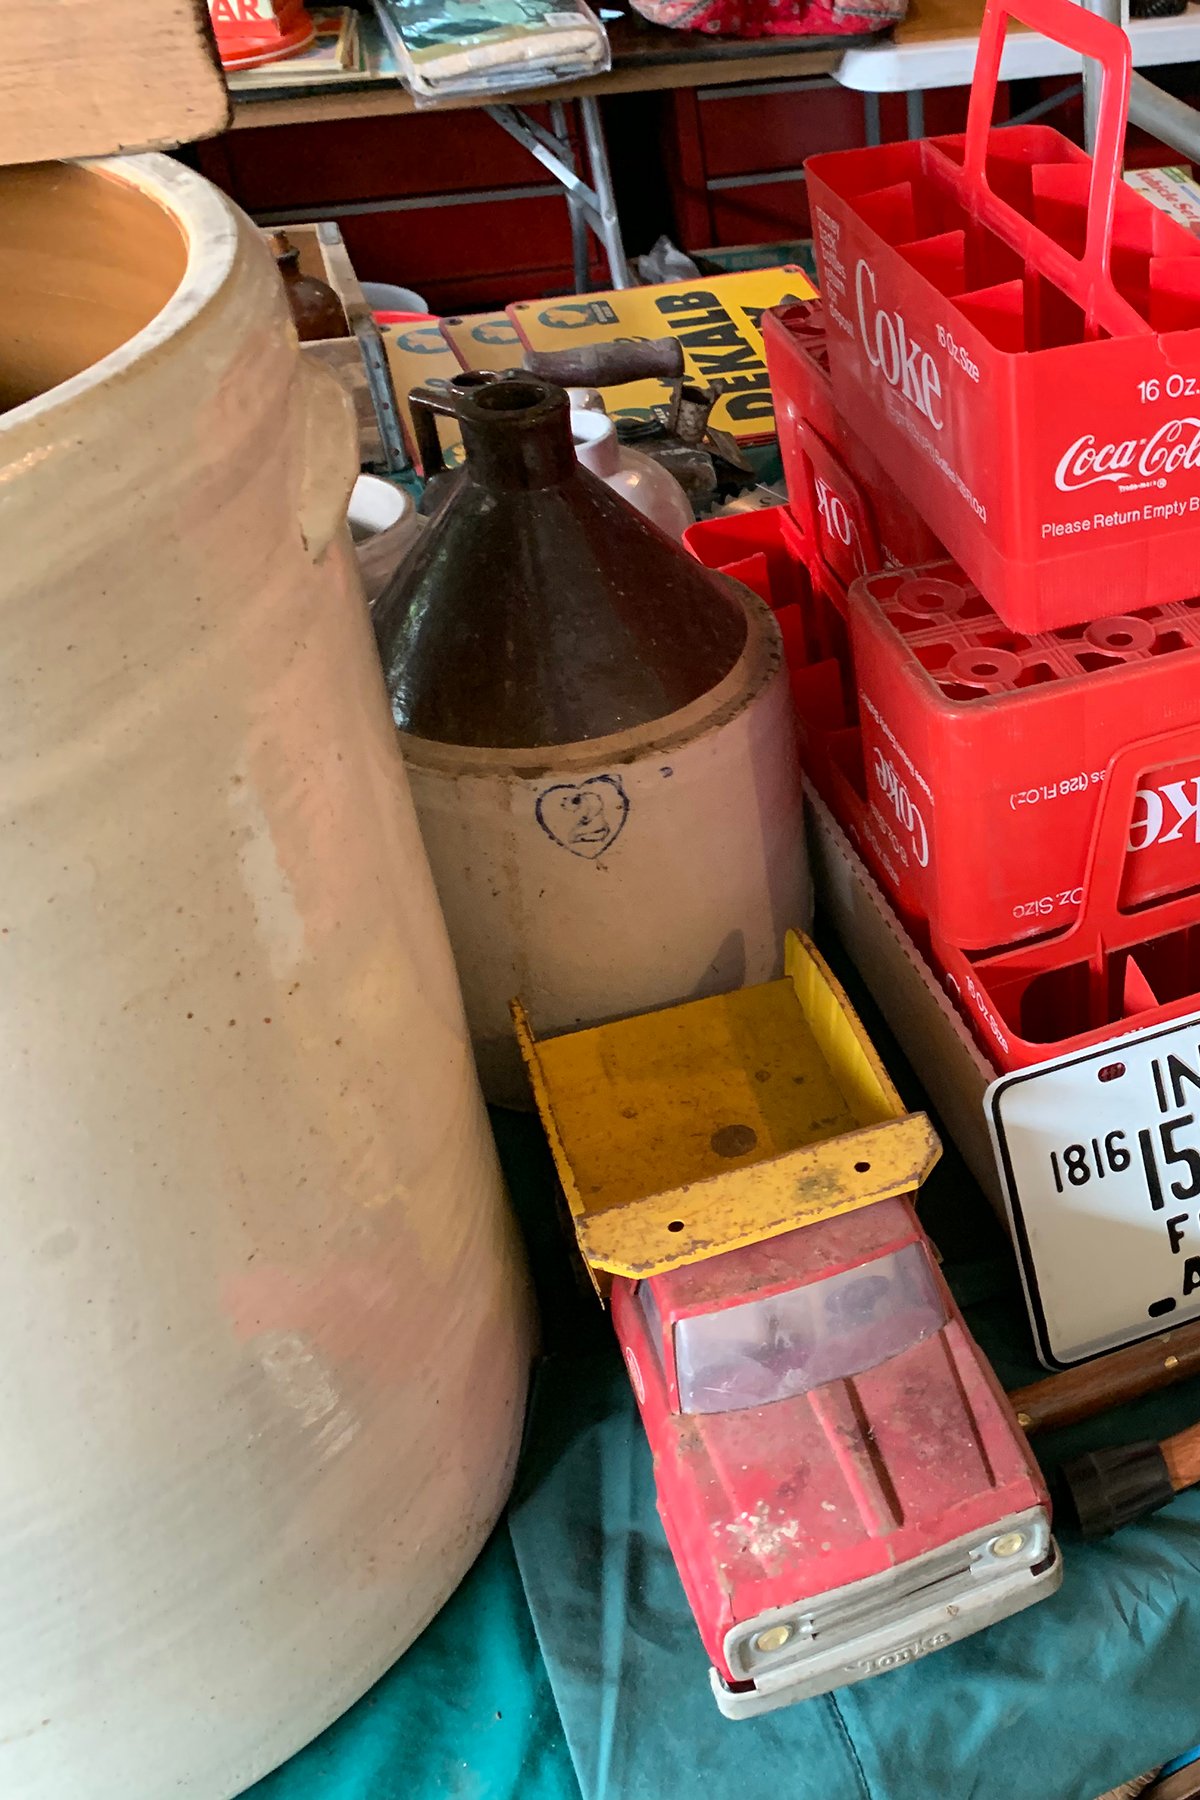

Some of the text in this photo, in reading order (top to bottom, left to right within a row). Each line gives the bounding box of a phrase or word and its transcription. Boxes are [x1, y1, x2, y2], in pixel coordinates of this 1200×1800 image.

[1172, 202, 1200, 221] Set
[655, 291, 775, 421] DEKALB
[855, 258, 944, 431] Coke
[1137, 379, 1161, 404] 16
[1166, 373, 1200, 399] Oz.
[1041, 518, 1092, 539] Please
[1093, 509, 1141, 529] Return
[1143, 499, 1187, 521] Empty
[873, 747, 930, 868] Coke
[1049, 1130, 1131, 1193] 1816
